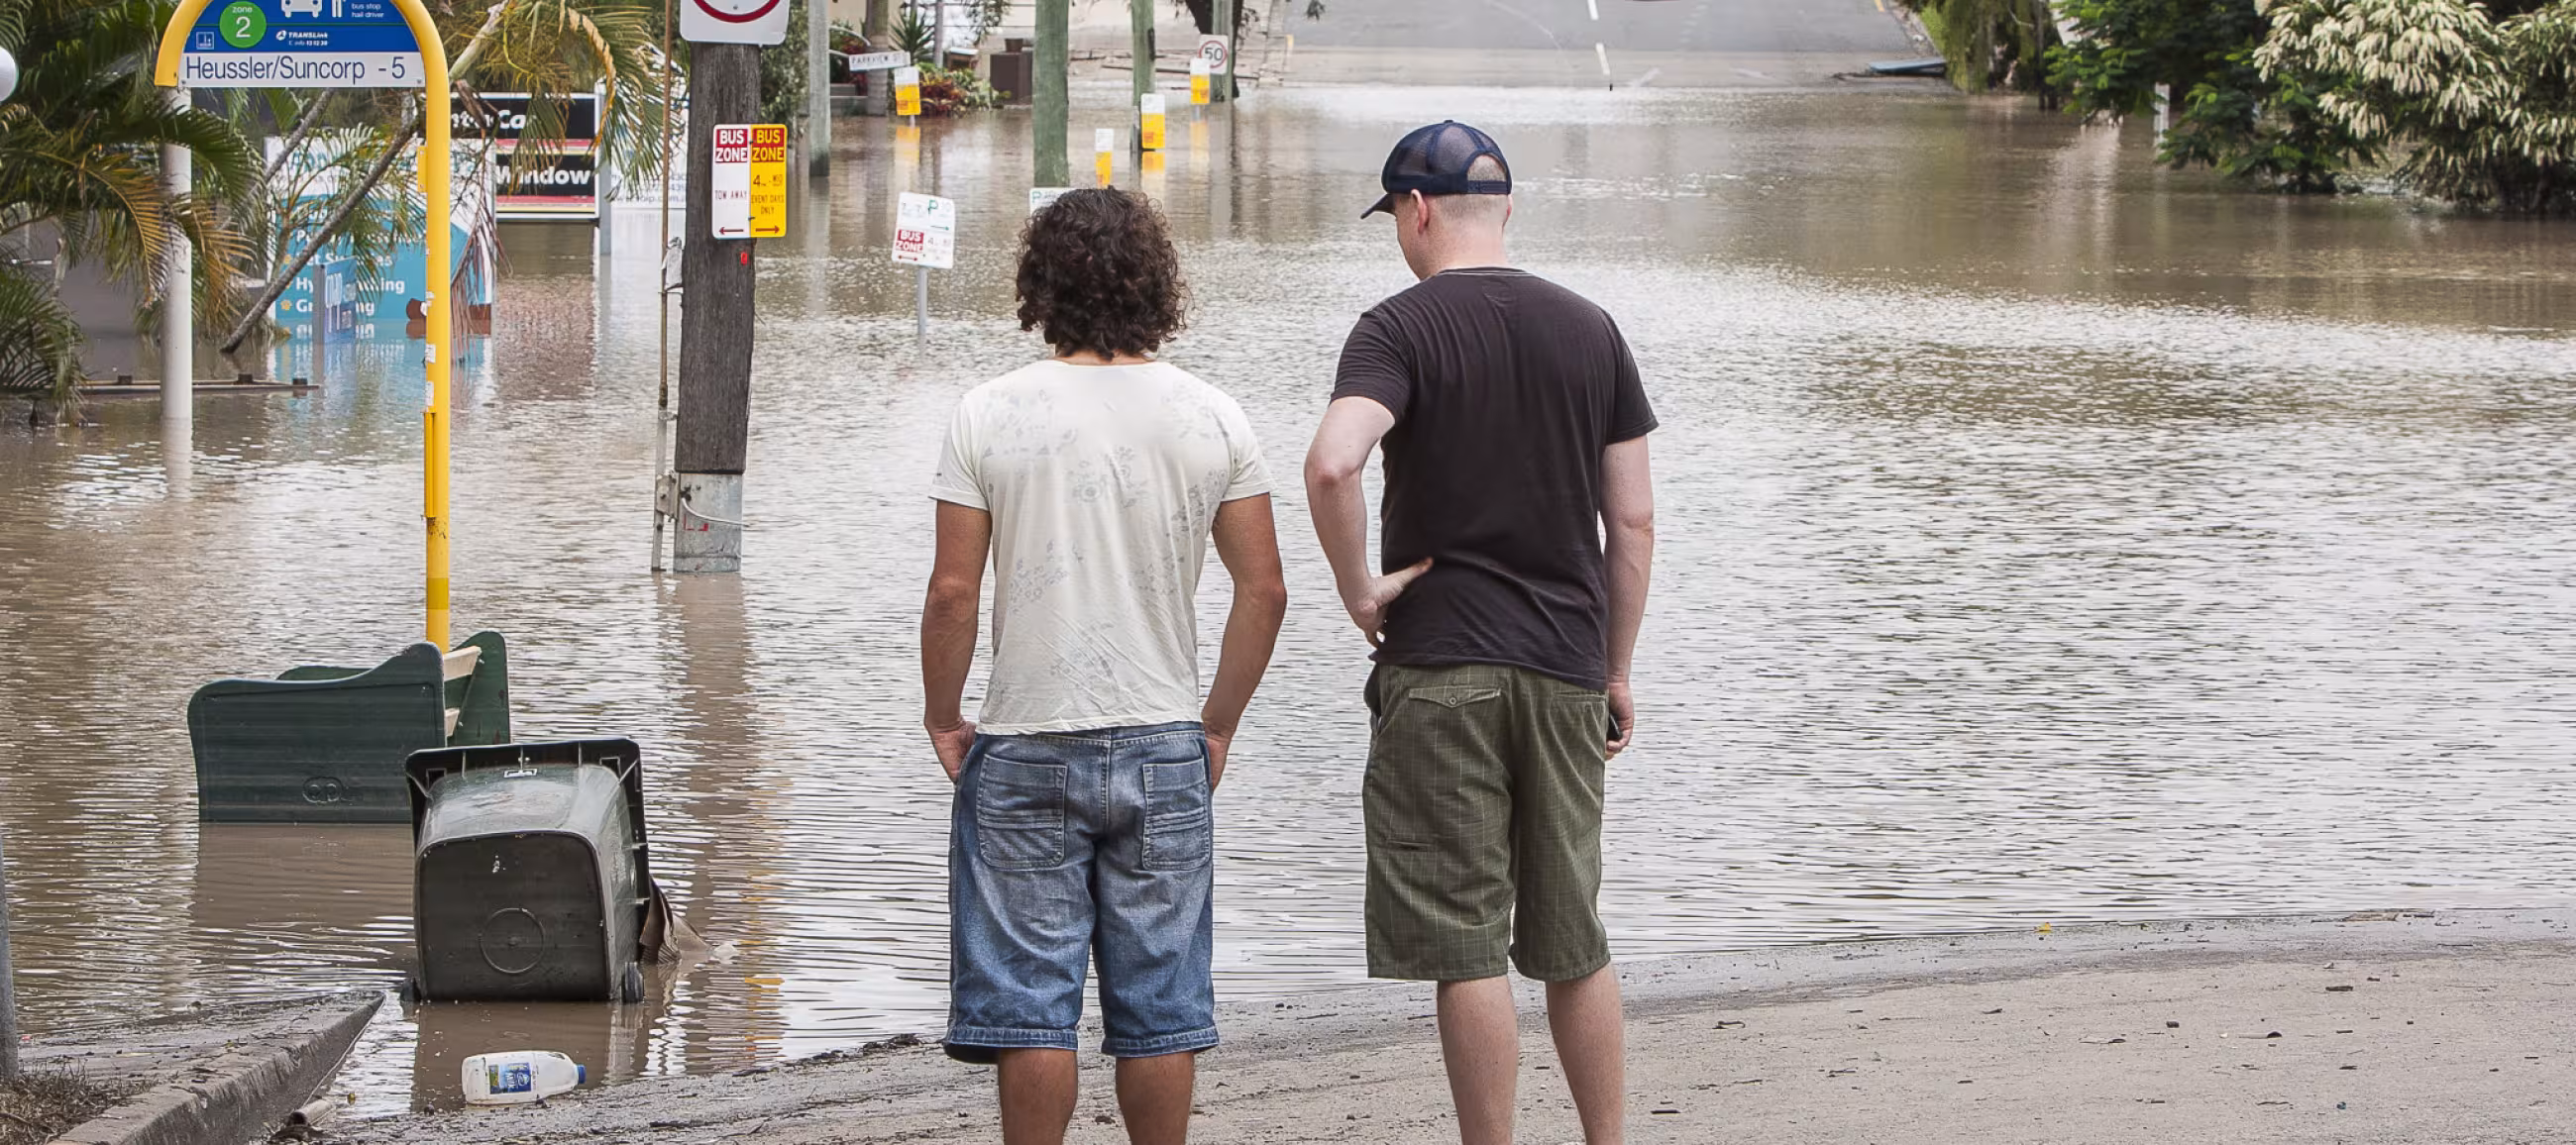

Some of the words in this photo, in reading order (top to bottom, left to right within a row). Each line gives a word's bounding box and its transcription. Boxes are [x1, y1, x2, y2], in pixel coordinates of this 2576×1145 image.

[235, 16, 251, 39] 2
[1205, 47, 1224, 61] 50
[186, 55, 366, 84] Heussler/Suncorp
[719, 129, 745, 145] BUS
[756, 129, 781, 145] BUS
[714, 147, 748, 162] ZONE
[752, 147, 785, 162] ZONE
[714, 189, 727, 200] TOW
[730, 189, 747, 199] AWAY
[901, 230, 921, 242] BUS
[896, 240, 923, 254] ZONE
